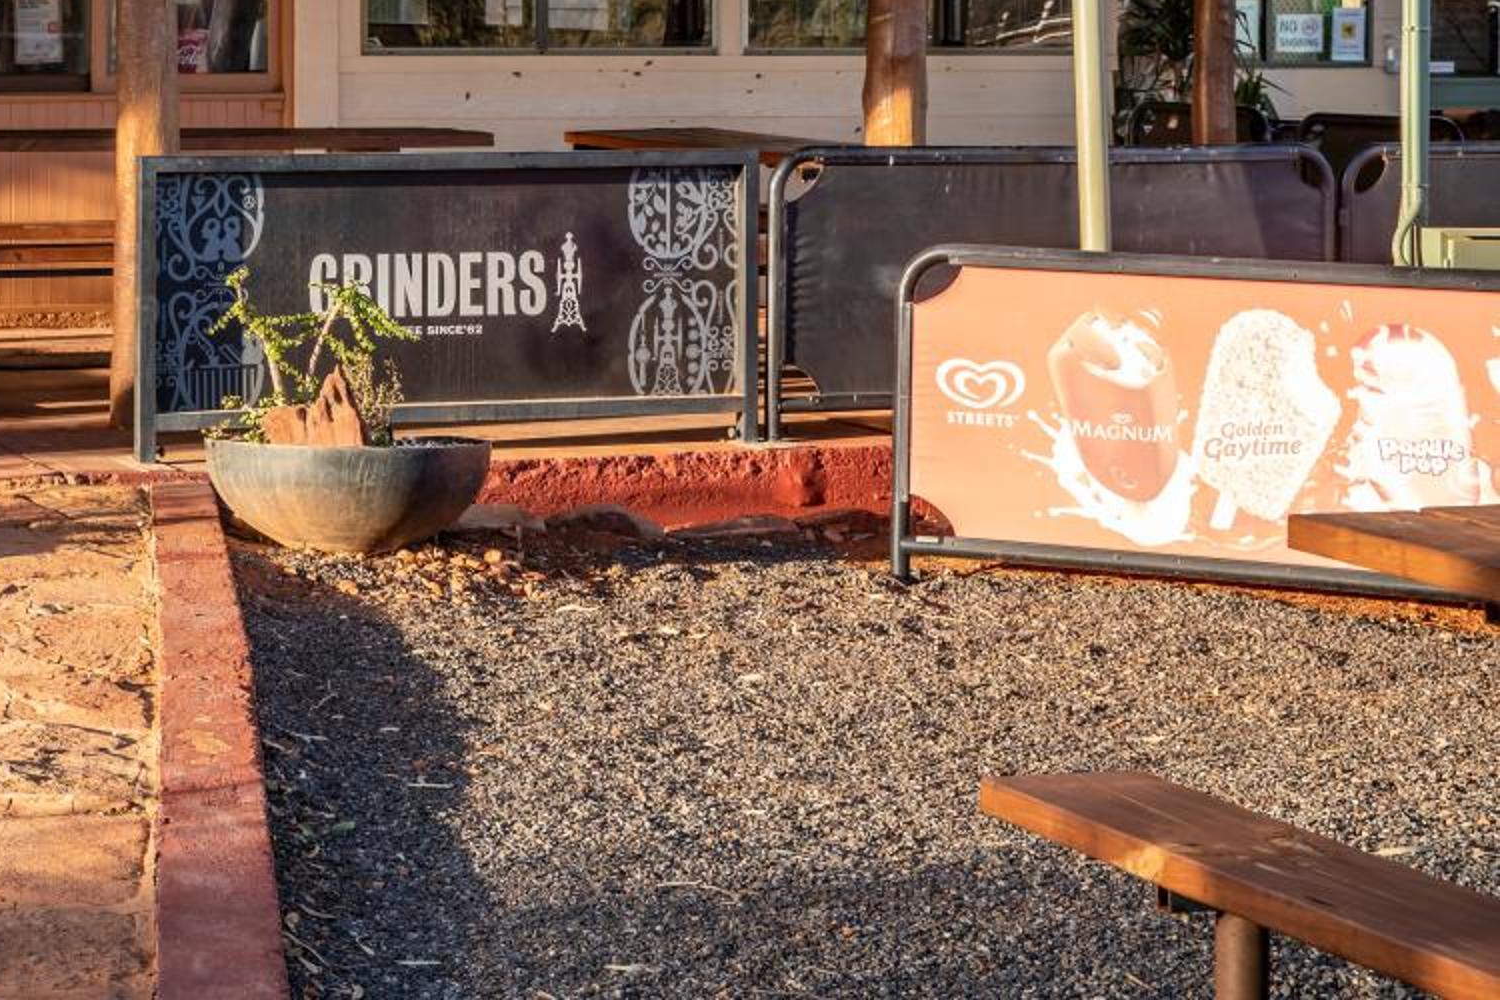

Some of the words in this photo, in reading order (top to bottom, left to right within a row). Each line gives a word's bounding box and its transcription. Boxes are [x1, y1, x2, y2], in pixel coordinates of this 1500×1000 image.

[310, 250, 547, 318] GRINDERS
[947, 411, 1013, 428] STREETS
[1072, 419, 1174, 444] MAGNUM
[1220, 422, 1284, 440] Golden
[1203, 435, 1303, 462] Gaytime
